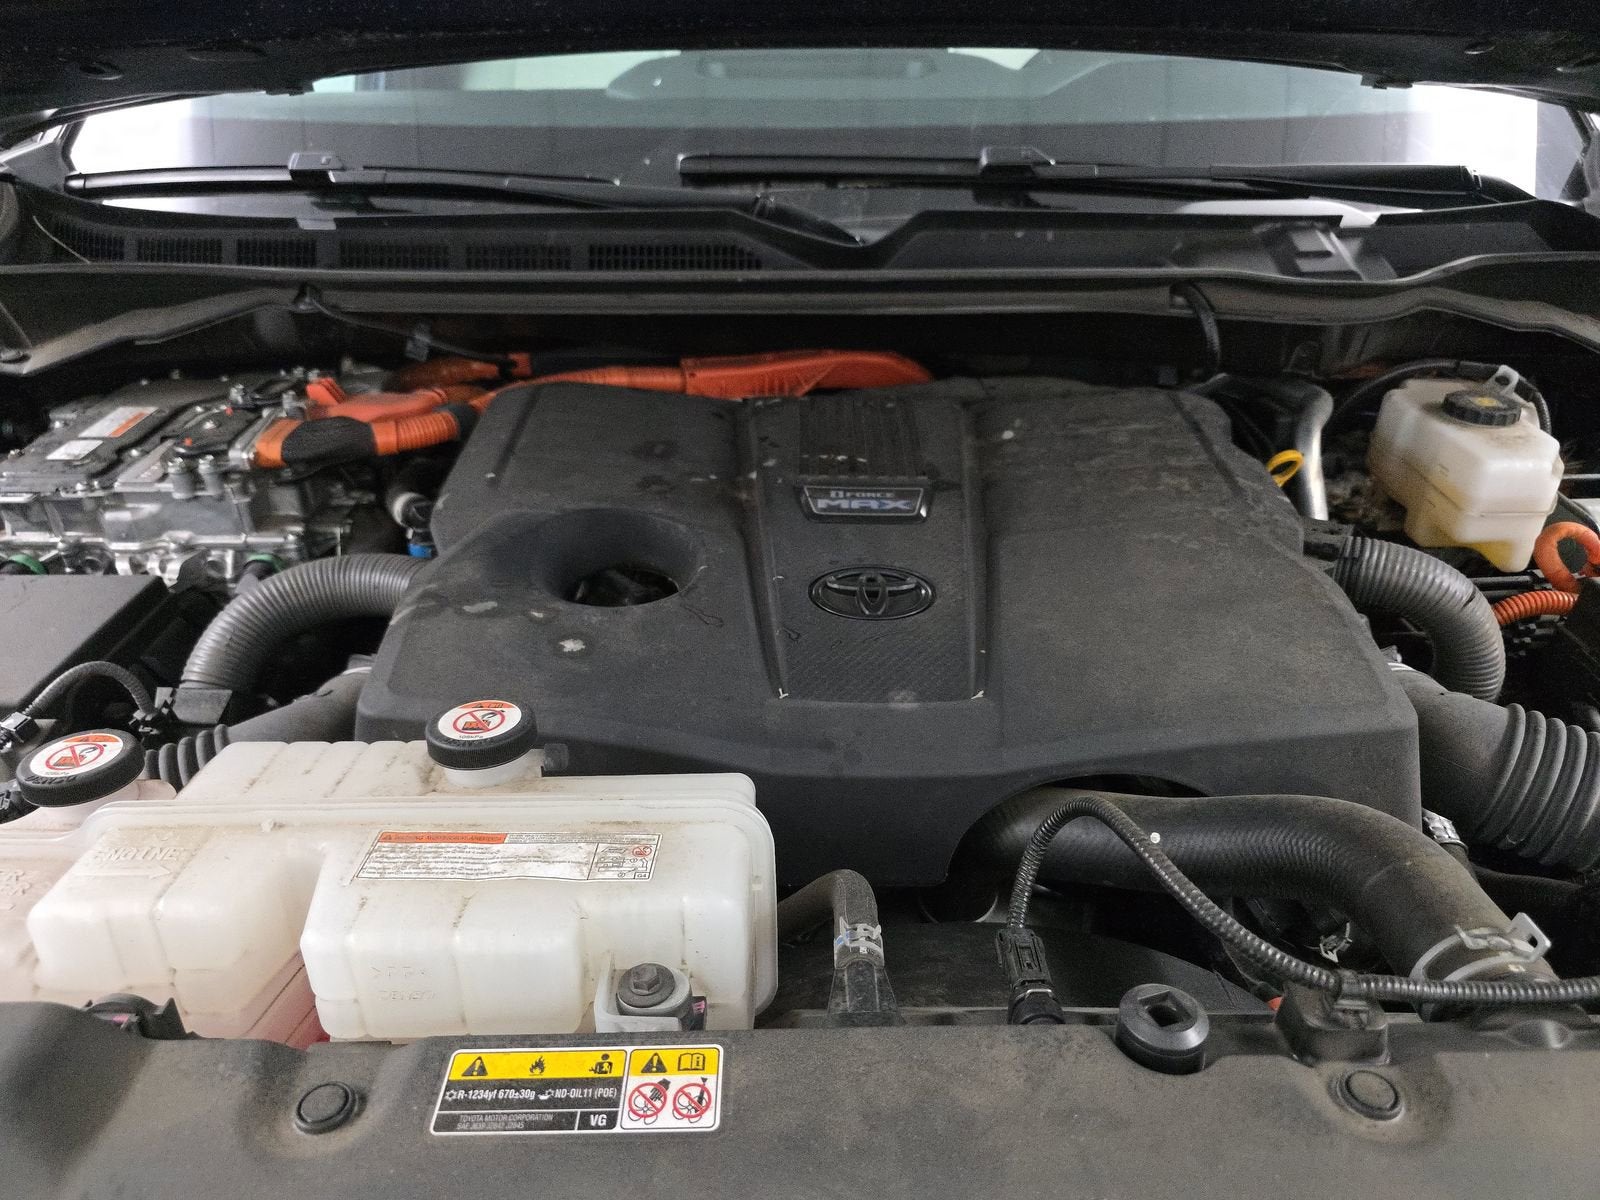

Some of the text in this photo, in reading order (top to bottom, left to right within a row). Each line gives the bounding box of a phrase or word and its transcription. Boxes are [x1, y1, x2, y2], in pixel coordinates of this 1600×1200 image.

[817, 499, 914, 509] MAX
[457, 1087, 617, 1101] R-1234yf 670±30g ND-OIL11 (POE)
[459, 1114, 484, 1122] TOYOTA
[508, 1113, 554, 1121] CORPORATION
[590, 1114, 608, 1126] VG
